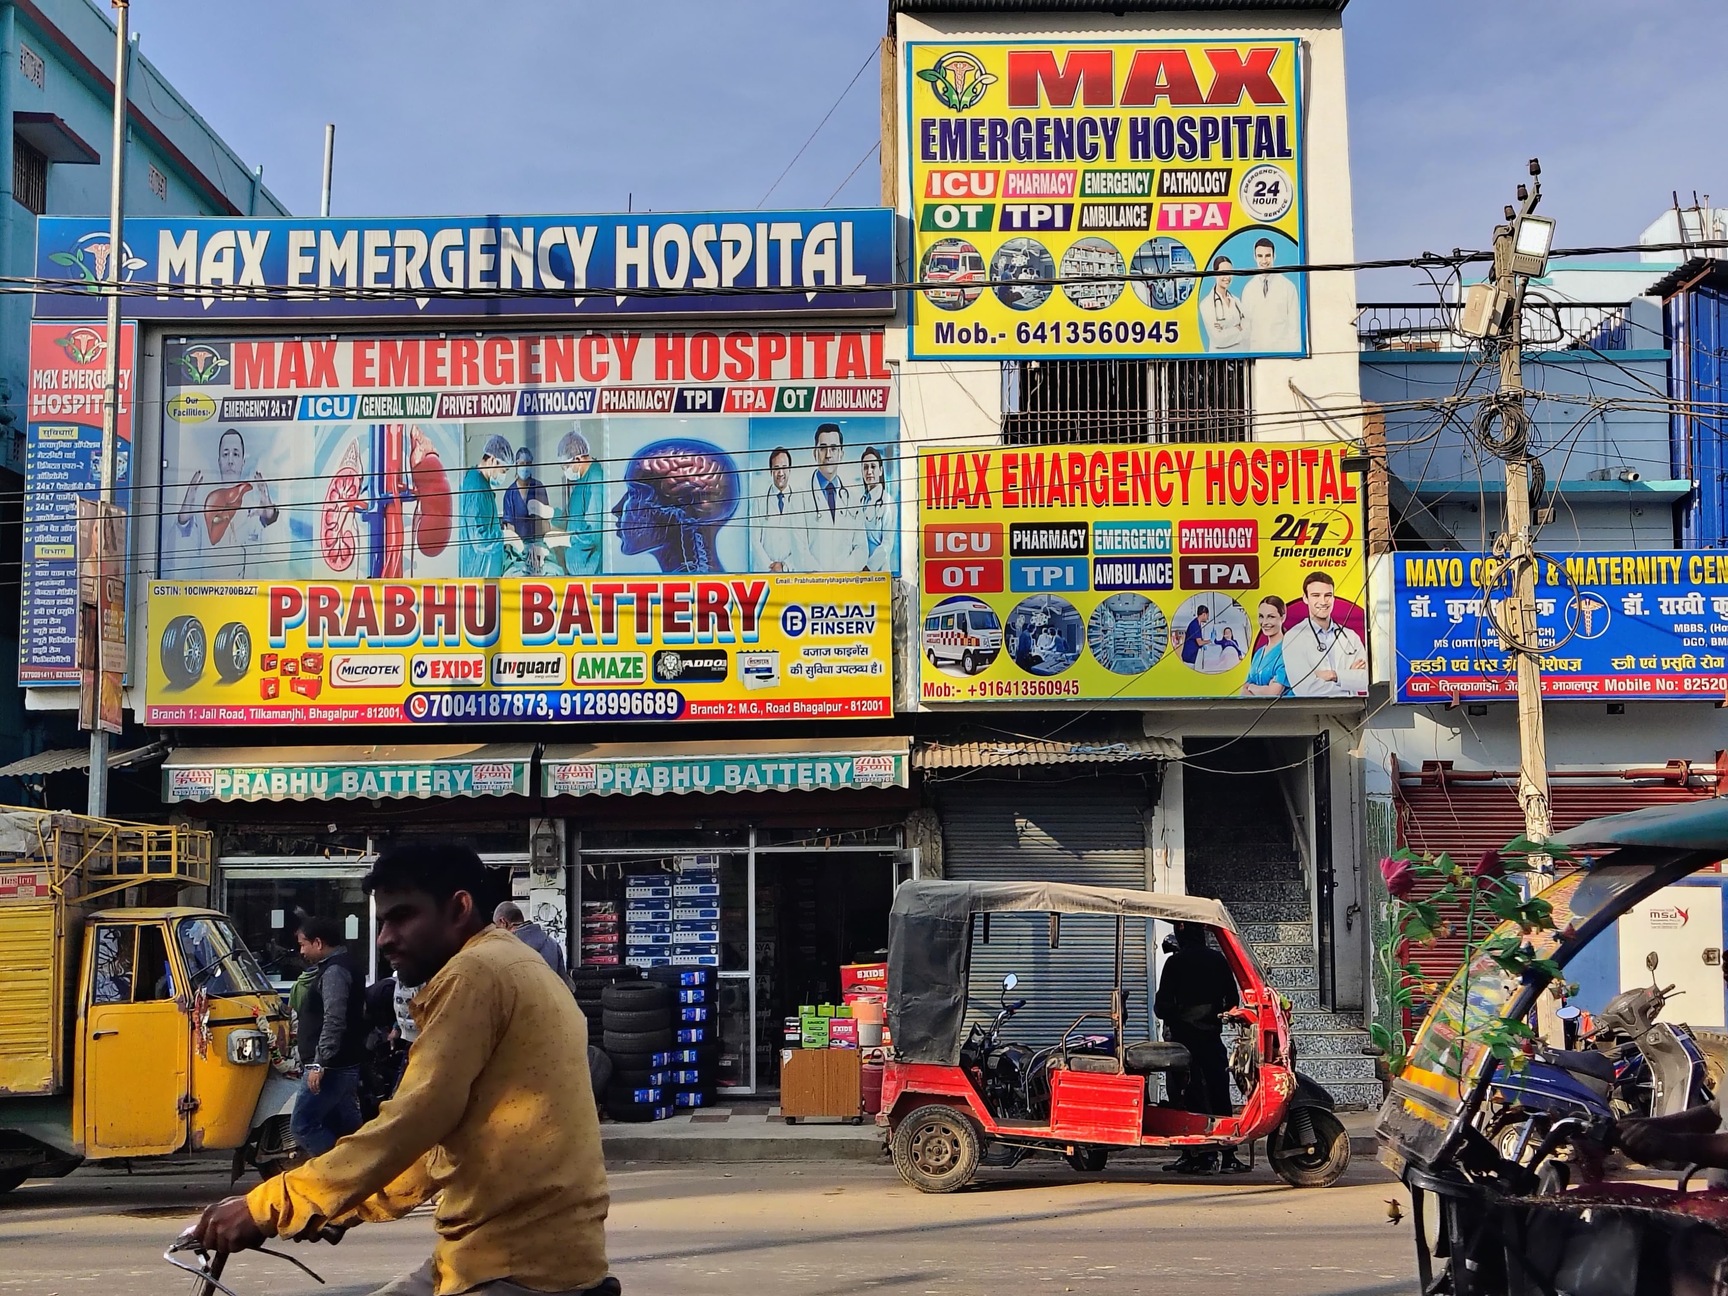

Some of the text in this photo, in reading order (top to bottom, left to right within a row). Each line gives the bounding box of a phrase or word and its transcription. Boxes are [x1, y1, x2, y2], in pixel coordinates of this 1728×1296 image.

[1007, 47, 1288, 108] MAX
[920, 115, 1293, 163] EMERGENCY HOSPITAL
[931, 171, 1227, 196] ICU PHARMACY EMERGENCY PATHOLOGY
[1253, 181, 1280, 197] 24
[934, 203, 1224, 229] OT TPI AMBULANCE TPA
[156, 221, 867, 311] MAX EMERGENCY HOSPITAL
[1016, 321, 1180, 344] 6413560945
[234, 331, 892, 390] MAX EMERGENCY HOSPITAL
[33, 369, 59, 390] MAX
[33, 394, 127, 416] HOSPITL
[185, 396, 199, 404] Our
[308, 397, 351, 417] ICU
[362, 396, 433, 417] GENERAL WARD
[442, 394, 511, 415] PRIVET ROOM
[523, 392, 592, 412] PATHOLOGY
[602, 390, 671, 411] PHARMACY
[684, 390, 712, 410] TPI
[732, 389, 767, 409] TPA
[783, 389, 808, 408] OT
[820, 389, 883, 409] AMBULANCE
[223, 400, 270, 418] EMERGENCY
[925, 448, 1357, 509] MAX EMARGENCY HOSPITAL
[935, 528, 1253, 552] ICU PHARMACY EMERGENCY PATHOLOGY
[1273, 546, 1352, 559] Emergency
[1300, 558, 1347, 568] Services
[1405, 558, 1464, 587] MAYO
[1546, 563, 1559, 586] &
[1566, 556, 1682, 586] MATERNITY
[942, 563, 1251, 587] OT TPI AMBULANCE TPA
[153, 586, 181, 595] GSTIN:
[811, 605, 875, 619] BAJAJ
[1409, 595, 1436, 618] डॉ.
[1622, 592, 1650, 616] डॉ.
[1658, 592, 1705, 615] राखी
[269, 580, 771, 649] PRABHU BATTERY
[811, 621, 875, 635] FINSERV
[1674, 624, 1707, 634] MBBS,
[803, 647, 831, 657] बजाज
[1434, 639, 1449, 648] MS
[1683, 637, 1708, 647] DGO,
[341, 665, 400, 676] MICROTEK
[430, 660, 483, 679] EXIDE
[496, 657, 561, 678] Livguard
[577, 657, 644, 679] AMAZE
[790, 663, 803, 674] की
[805, 663, 834, 678] सुविधा
[1451, 656, 1470, 672] एवं
[1639, 654, 1657, 669] एवं
[1700, 656, 1725, 669] रोग
[967, 680, 1080, 697] +916413560945
[1553, 681, 1600, 693] भागलपुर
[1604, 678, 1728, 691] Mobile No: 82520
[429, 691, 678, 718] 7004187873, 9128996689
[690, 703, 725, 715] Branch
[766, 702, 791, 714] Road
[793, 701, 842, 716] Bhagalpur
[850, 700, 883, 712] 812001
[151, 708, 186, 720] Branch
[200, 708, 217, 720] Jail
[219, 708, 247, 721] Road,
[309, 708, 358, 722] Bhagalpur
[367, 708, 404, 720] 812001,
[216, 769, 472, 795] PRABHU BATTERY
[598, 761, 853, 789] PRABHU BATTERY
[1650, 911, 1677, 919] msd
[857, 968, 884, 979] EXIDE
